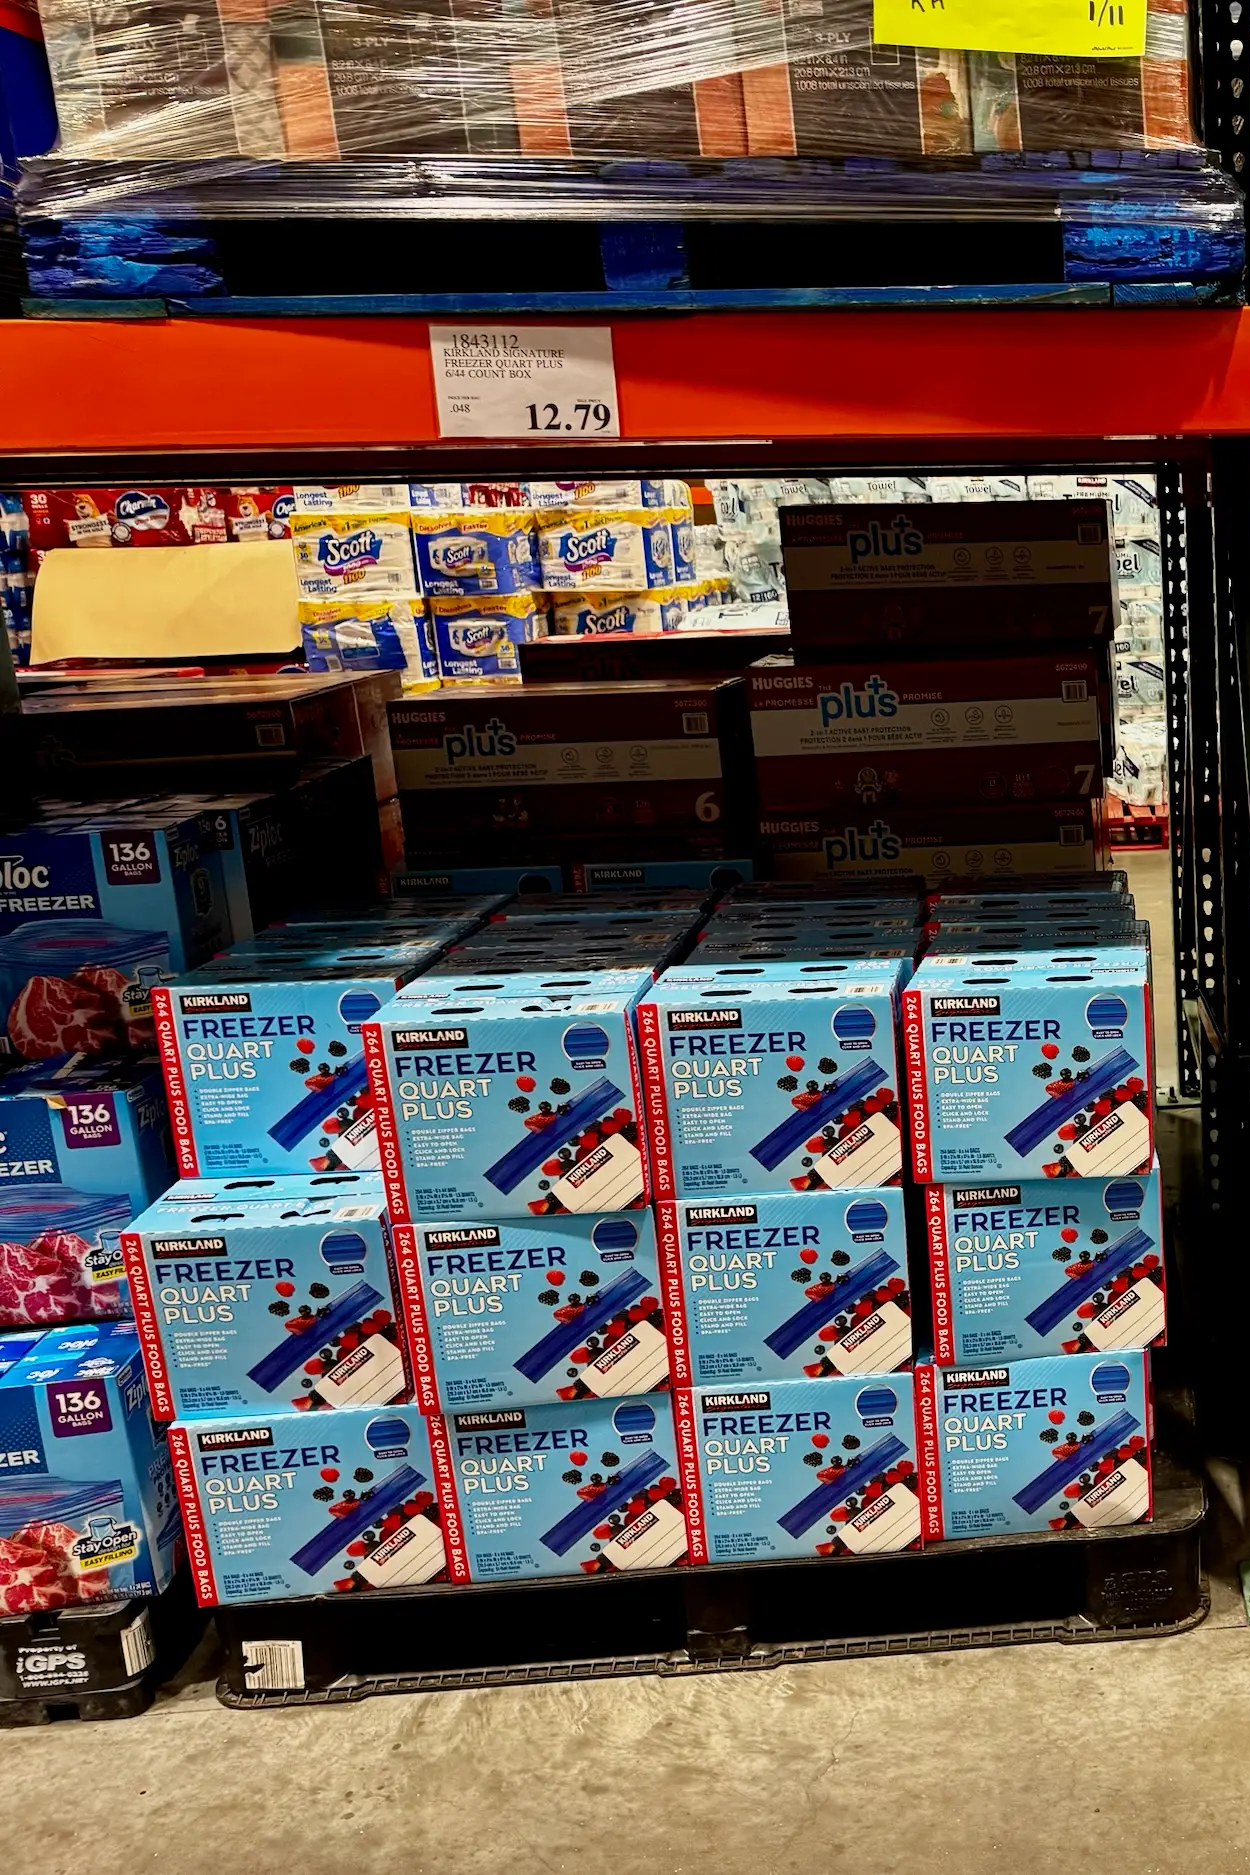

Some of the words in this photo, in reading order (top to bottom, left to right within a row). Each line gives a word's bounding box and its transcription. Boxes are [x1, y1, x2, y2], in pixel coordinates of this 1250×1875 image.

[819, 80, 837, 90] total
[885, 79, 915, 89] tissues
[453, 335, 519, 349] 1843112
[444, 349, 500, 357] KIRKLAND
[503, 350, 565, 358] SIGNATURE
[445, 360, 493, 368] FREEZER
[496, 360, 533, 369] QUART
[537, 360, 563, 368] PLUS
[445, 370, 465, 378] 6/44
[469, 370, 506, 378] COUNT
[509, 370, 532, 378] BOX
[450, 404, 470, 413] .048
[525, 404, 610, 431] 12.79
[419, 521, 452, 533] Dissolves
[462, 521, 488, 532] Faster
[326, 530, 375, 564] Scott
[564, 530, 609, 561] Scott
[446, 547, 471, 564] Scott
[301, 578, 331, 588] Longest
[343, 569, 366, 584] 1100
[308, 584, 337, 593] Lasting
[752, 677, 814, 690] HUGGIES
[766, 698, 814, 707] PROMESSE
[902, 692, 943, 700] PROMISE
[392, 712, 446, 723] HUGGIES
[1074, 765, 1095, 794] 7
[695, 791, 720, 822] 6
[183, 995, 248, 1007] KIRKLAND
[642, 1011, 653, 1034] 264
[672, 1011, 738, 1023] KIRKLAND
[183, 1015, 316, 1039] FREEZER
[187, 1040, 274, 1061] QUART
[670, 1032, 806, 1056] FREEZER
[643, 1037, 660, 1081] QUART
[671, 1058, 762, 1078] QUART
[190, 1061, 257, 1080] PLUS
[673, 1080, 742, 1099] PLUS
[650, 1085, 663, 1116] PLUS
[653, 1119, 667, 1149] FOOD
[656, 1153, 670, 1191] BAGS
[957, 1189, 1018, 1201] KIRKLAND
[954, 1206, 1080, 1233] FREEZER
[954, 1231, 1039, 1254] QUART
[956, 1252, 1020, 1273] PLUS
[55, 1392, 101, 1413] 136
[58, 1412, 104, 1424] GALLON
[72, 1420, 92, 1428] BAGS
[73, 1540, 102, 1558] Stay
[102, 1530, 137, 1549] Open
[84, 1555, 104, 1567] EASY
[104, 1549, 134, 1563] FILLING
[16, 1652, 85, 1673] iGPS
